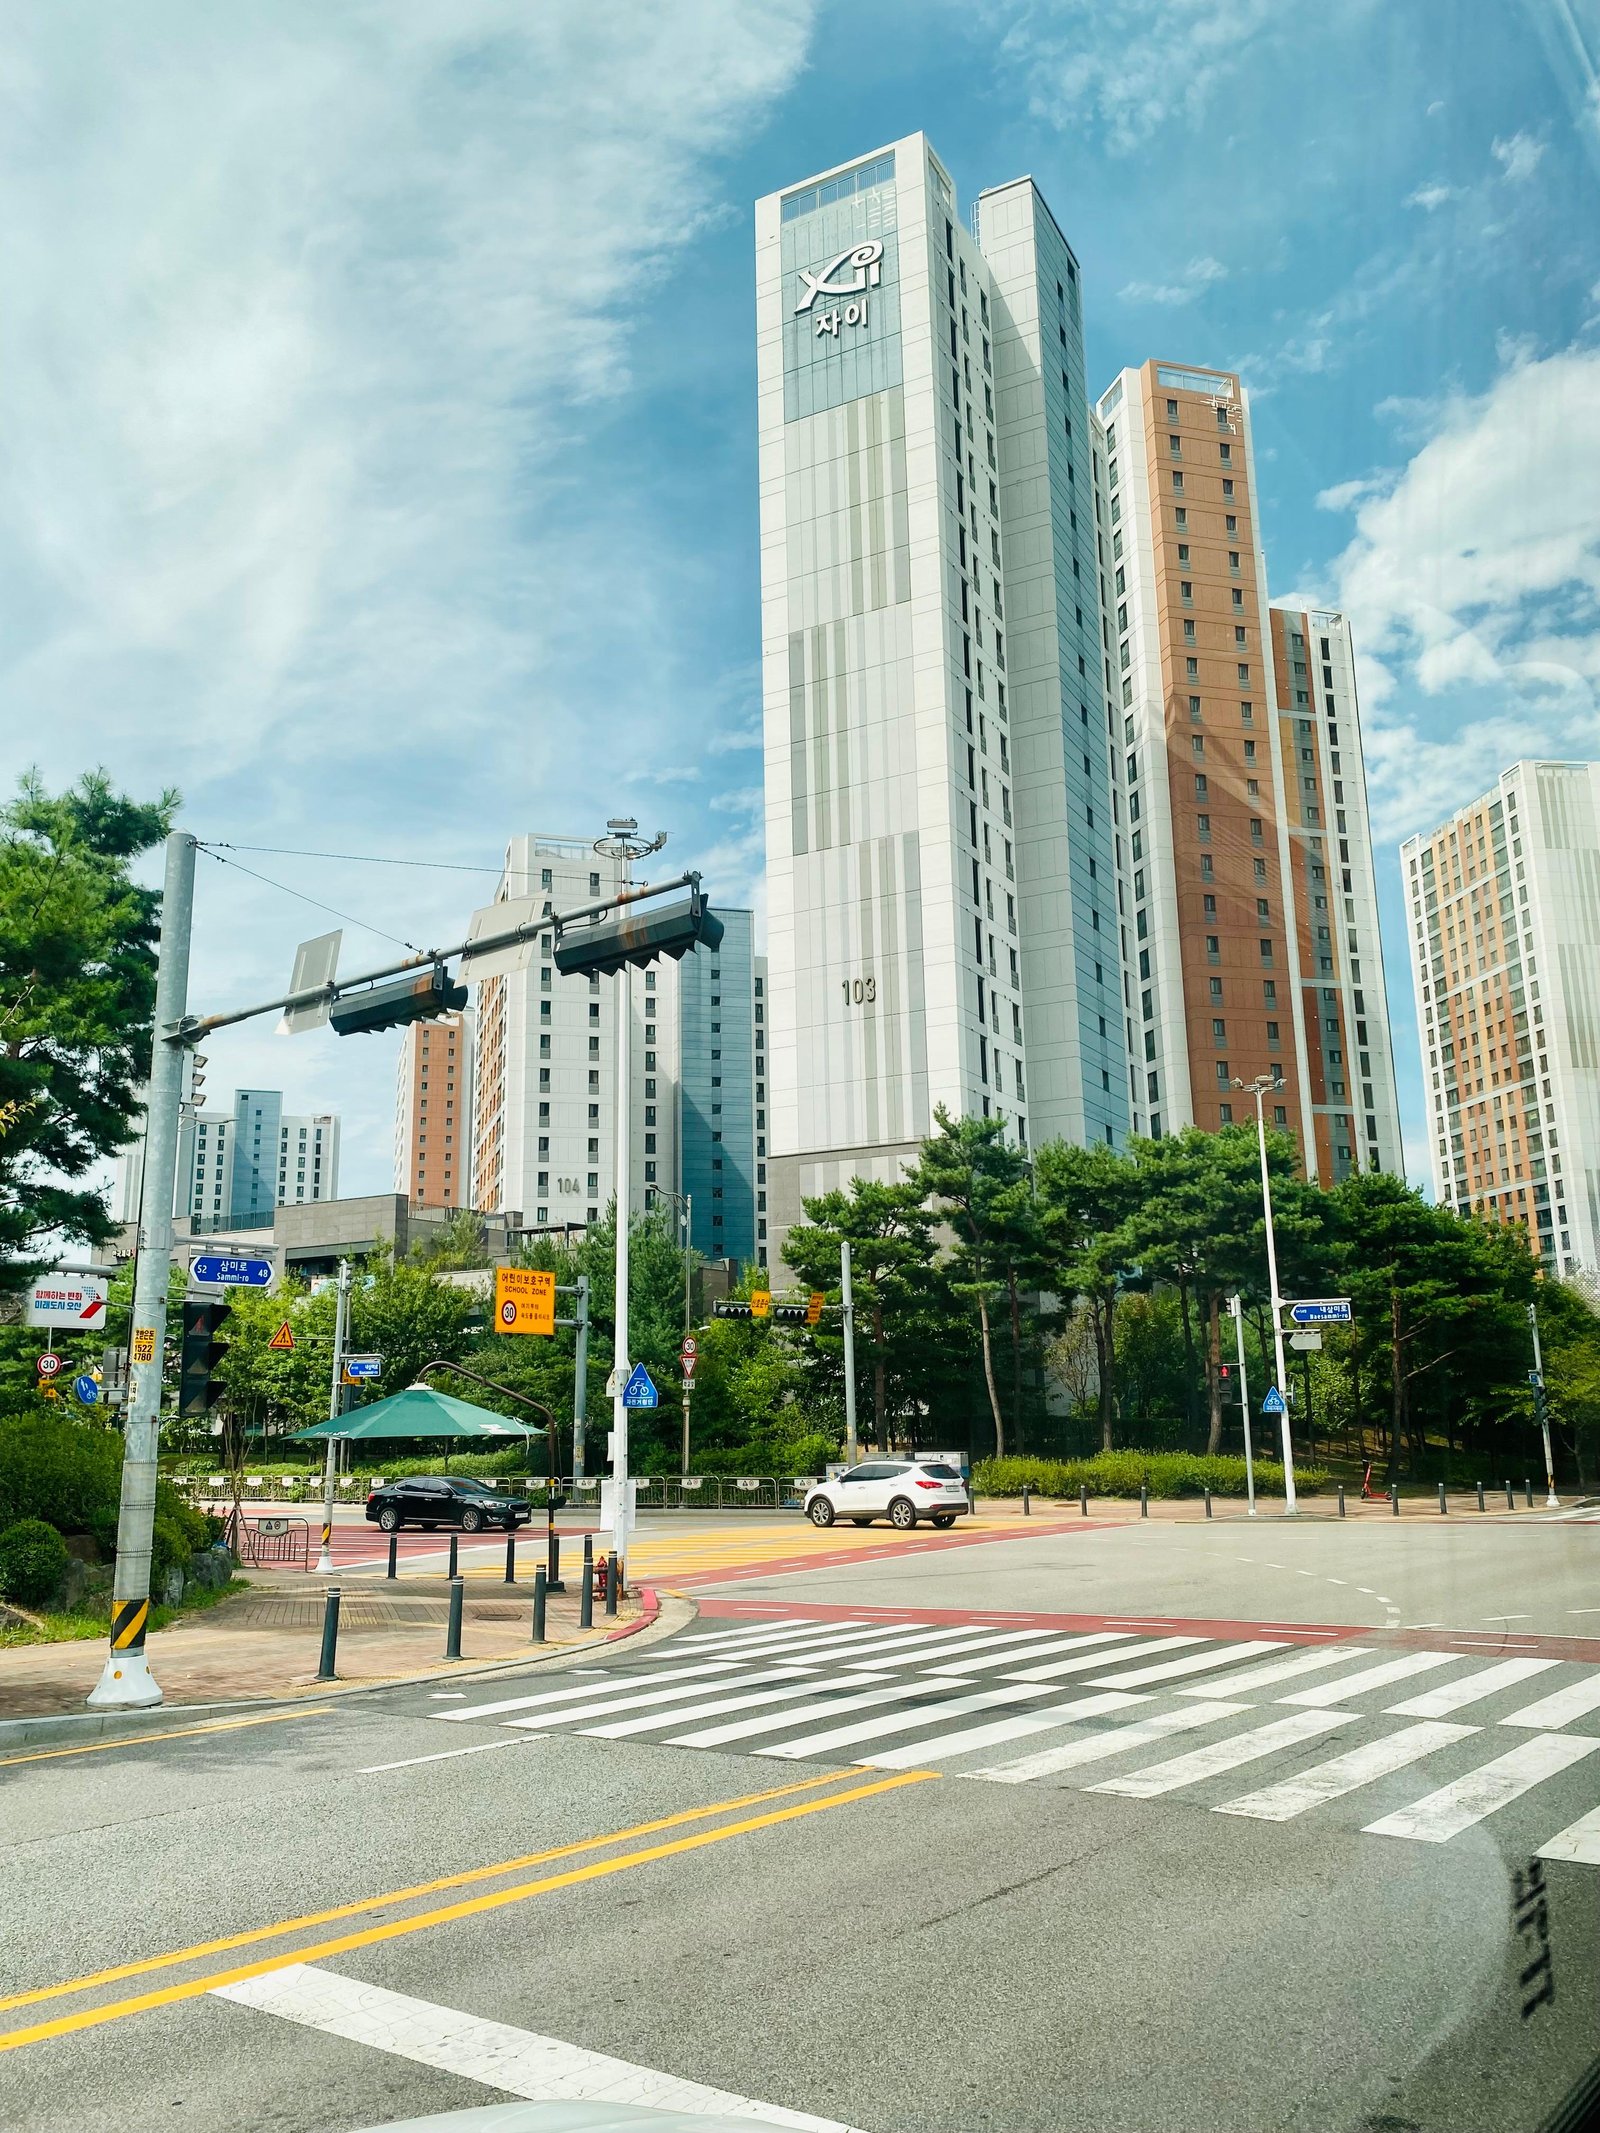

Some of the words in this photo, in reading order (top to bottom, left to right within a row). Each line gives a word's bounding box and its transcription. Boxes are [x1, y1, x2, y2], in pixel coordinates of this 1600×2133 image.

[815, 298, 868, 338] 자이
[842, 976, 876, 1006] 103
[557, 1177, 580, 1194] 104
[197, 1264, 208, 1274] 52
[220, 1260, 248, 1272] 삼미로
[216, 1272, 250, 1282] Sammi-ro
[258, 1269, 269, 1278] 48
[501, 1273, 551, 1287] 어린이보호구역
[36, 1290, 66, 1300] 함께하는
[67, 1291, 83, 1301] 변화
[504, 1285, 528, 1294] SCHOOL
[531, 1288, 547, 1296] ZONE
[35, 1300, 65, 1310] 미래도시
[66, 1301, 82, 1311] 오산
[1320, 1305, 1347, 1313] 내삼미로
[504, 1306, 514, 1319] 30
[134, 1344, 153, 1353] 1522
[133, 1352, 152, 1362] 4780
[43, 1360, 55, 1368] 30
